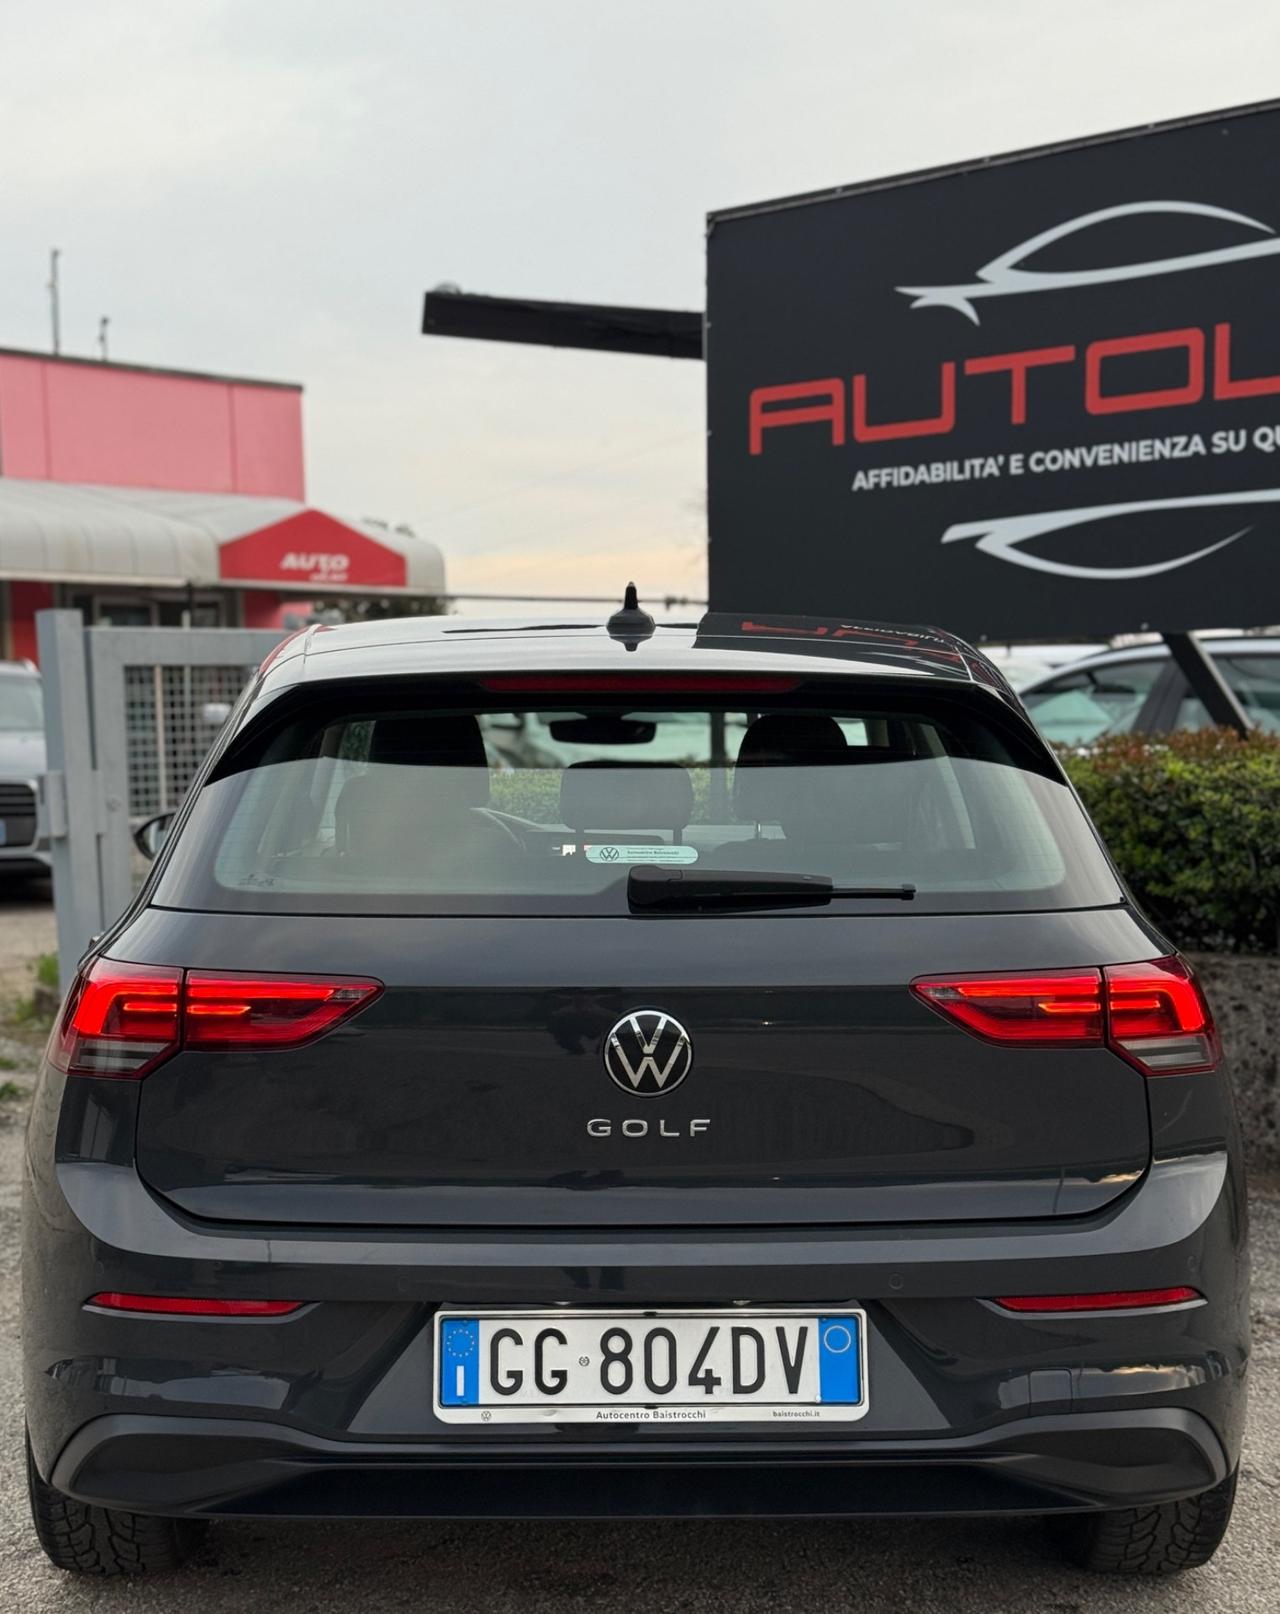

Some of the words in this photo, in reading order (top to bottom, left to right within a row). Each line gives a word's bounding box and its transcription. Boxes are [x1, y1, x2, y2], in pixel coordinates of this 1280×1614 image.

[851, 454, 1005, 491] AFFIDABILITA'
[1009, 453, 1025, 475] E
[1029, 434, 1207, 473] CONVENIENZA
[1211, 428, 1246, 454] SU
[1253, 424, 1280, 453] Q
[280, 552, 350, 573] AUTO
[586, 1118, 711, 1137] GOLF
[456, 1365, 465, 1397] I
[596, 1410, 650, 1420] Autocentro
[652, 1410, 707, 1420] Baistrocchi
[772, 1410, 820, 1418] baistrocchi.it
